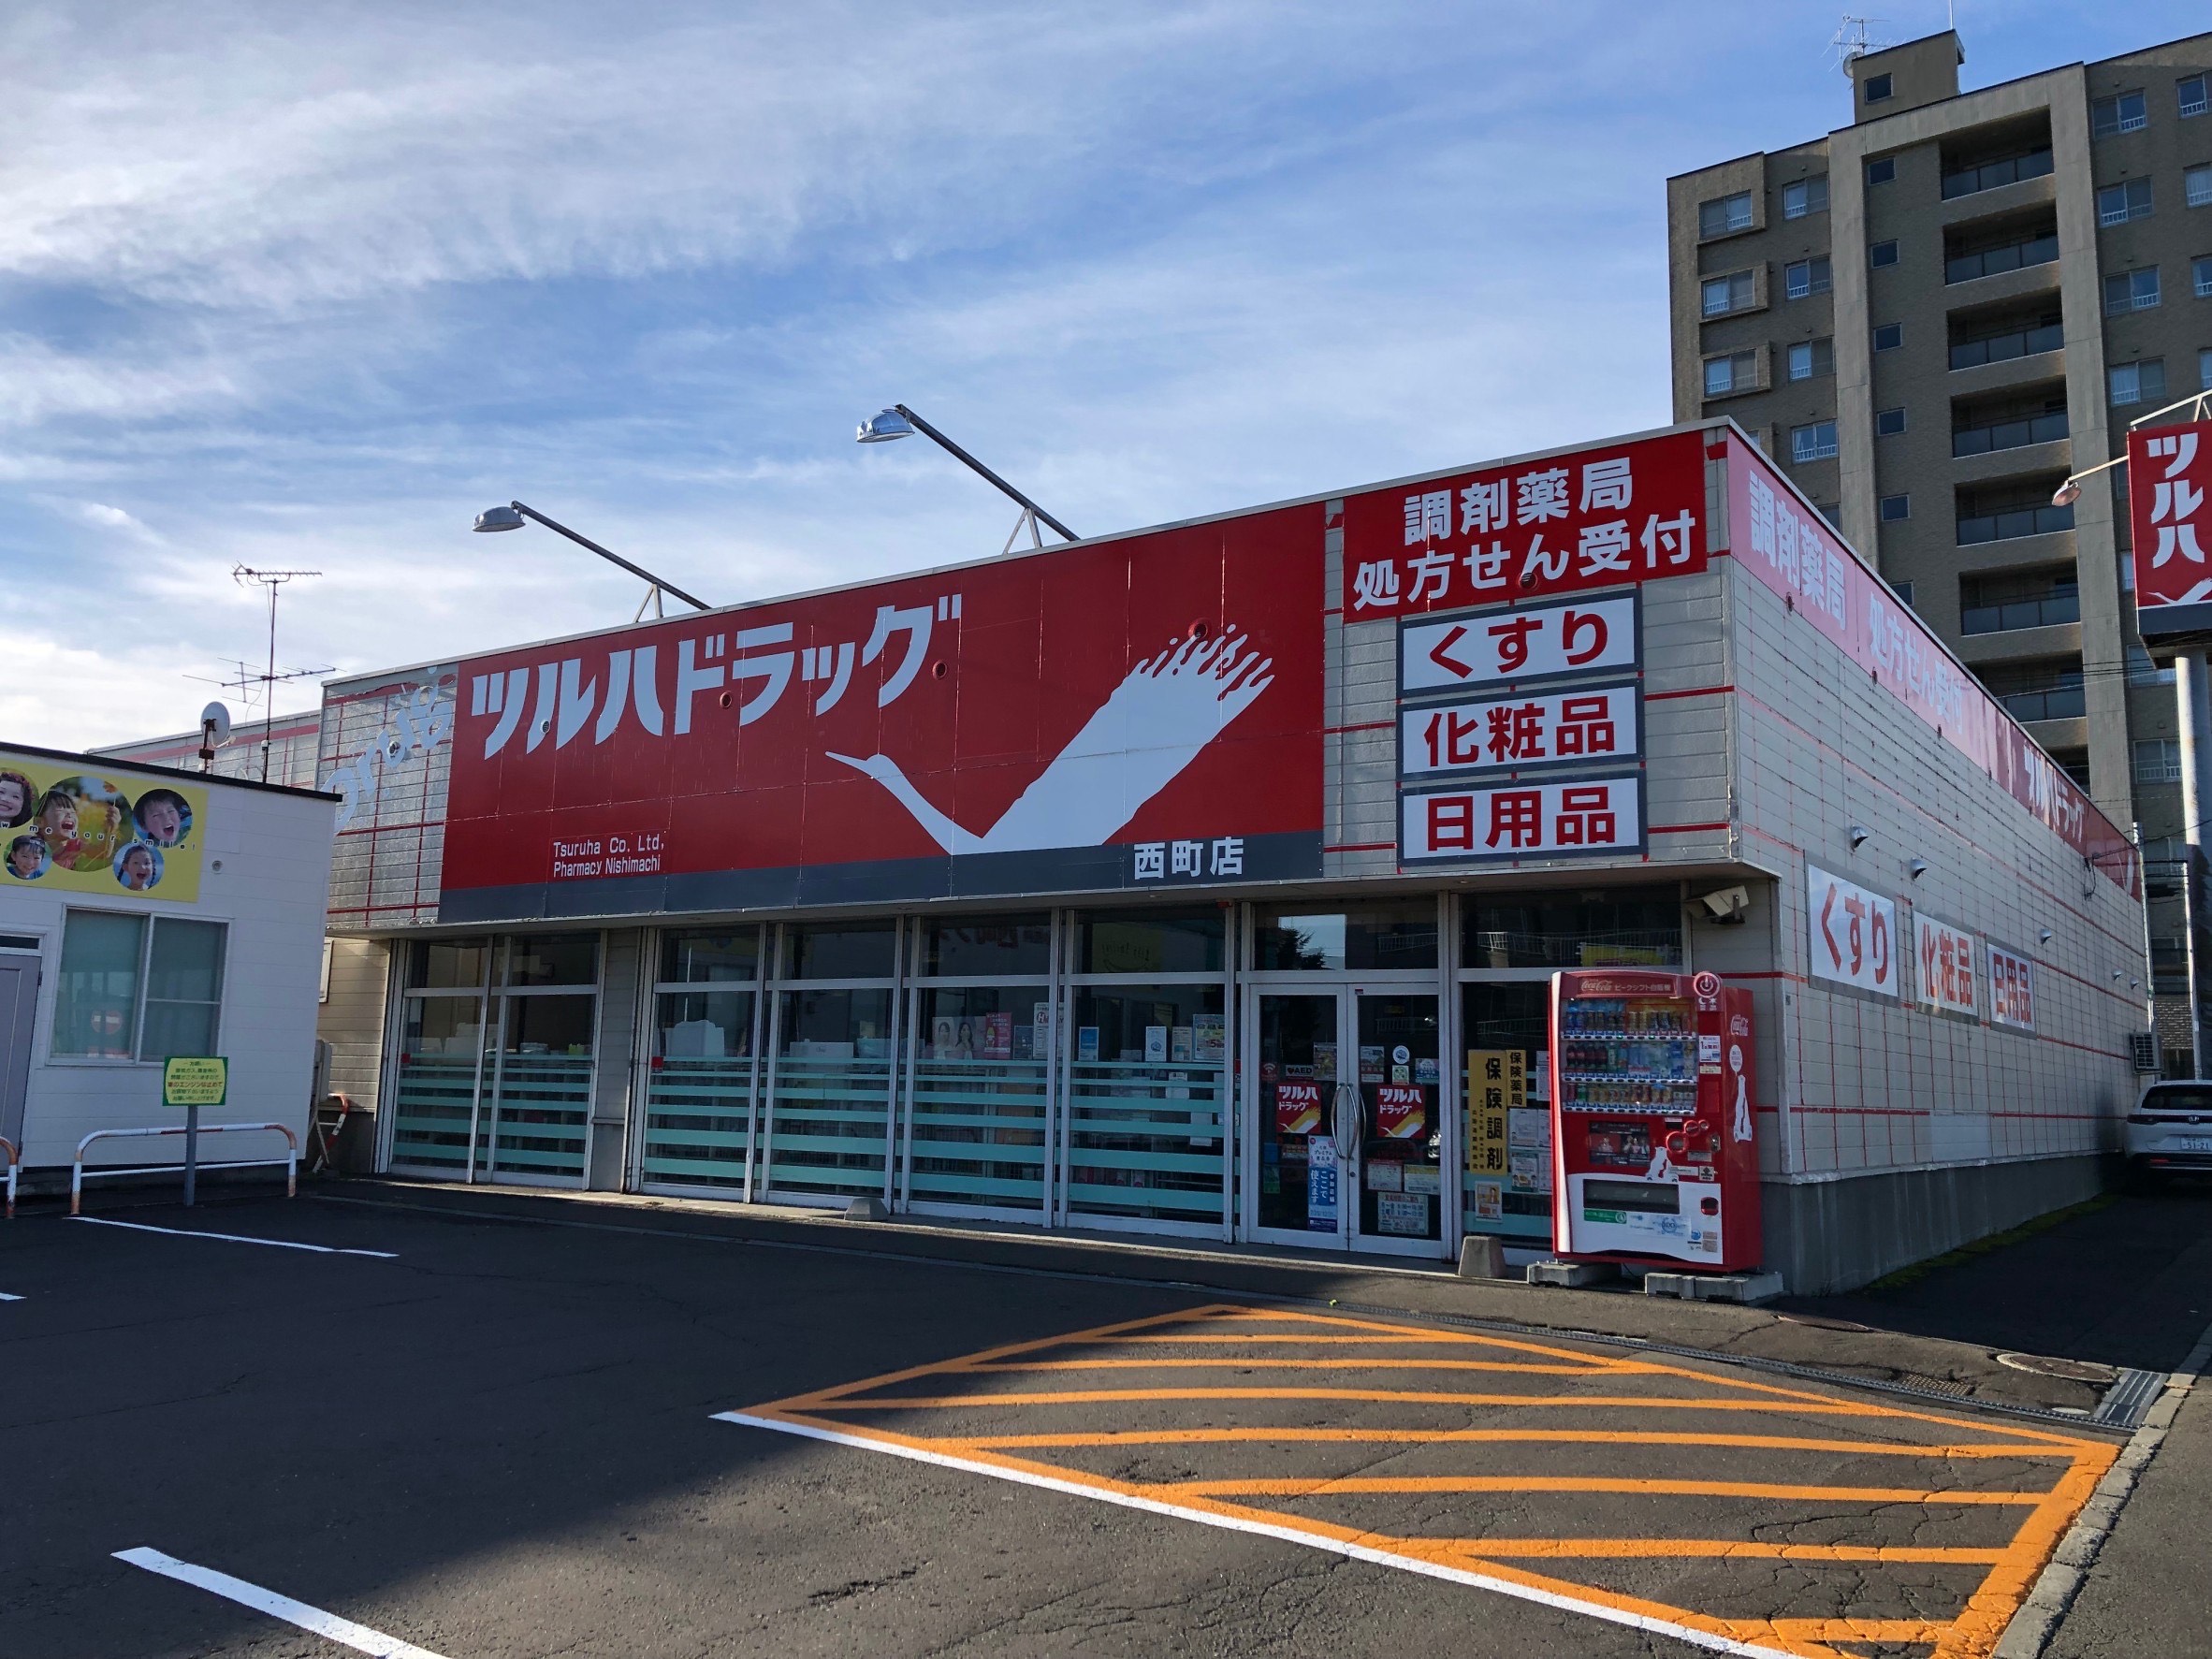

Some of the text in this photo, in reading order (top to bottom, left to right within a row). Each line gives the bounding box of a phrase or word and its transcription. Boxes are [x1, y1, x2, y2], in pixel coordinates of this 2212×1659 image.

[1404, 457, 1633, 546] 調剤薬局
[2146, 431, 2205, 569] ツルハ
[1353, 508, 1696, 612] 処方せん受付
[1749, 469, 1846, 631] 調剤薬局
[472, 594, 962, 760] ツルハドラッグ
[1429, 610, 1608, 679] くすり
[1870, 590, 1963, 735] 処方せん受付
[1423, 695, 1615, 767] 化粧品
[29, 825, 52, 834] me
[70, 831, 117, 841] your
[553, 838, 601, 858] Tsuruha
[609, 837, 631, 853] Co.
[1427, 786, 1616, 851] 日用品
[553, 854, 661, 878] Pharmacy Nishimachi
[1133, 836, 1244, 880] 西町店
[1821, 881, 1888, 985] くすり
[1921, 923, 1973, 1008] 化粧品
[1992, 953, 2032, 1025] 日用品
[1278, 1085, 1318, 1100] ツルハ
[1278, 1101, 1309, 1111] ドラッグ
[1379, 1088, 1422, 1104] ツルハ
[1379, 1105, 1413, 1114] ドラッグ
[1485, 1057, 1503, 1171] 保険調剤
[1509, 1052, 1523, 1106] 保険薬局
